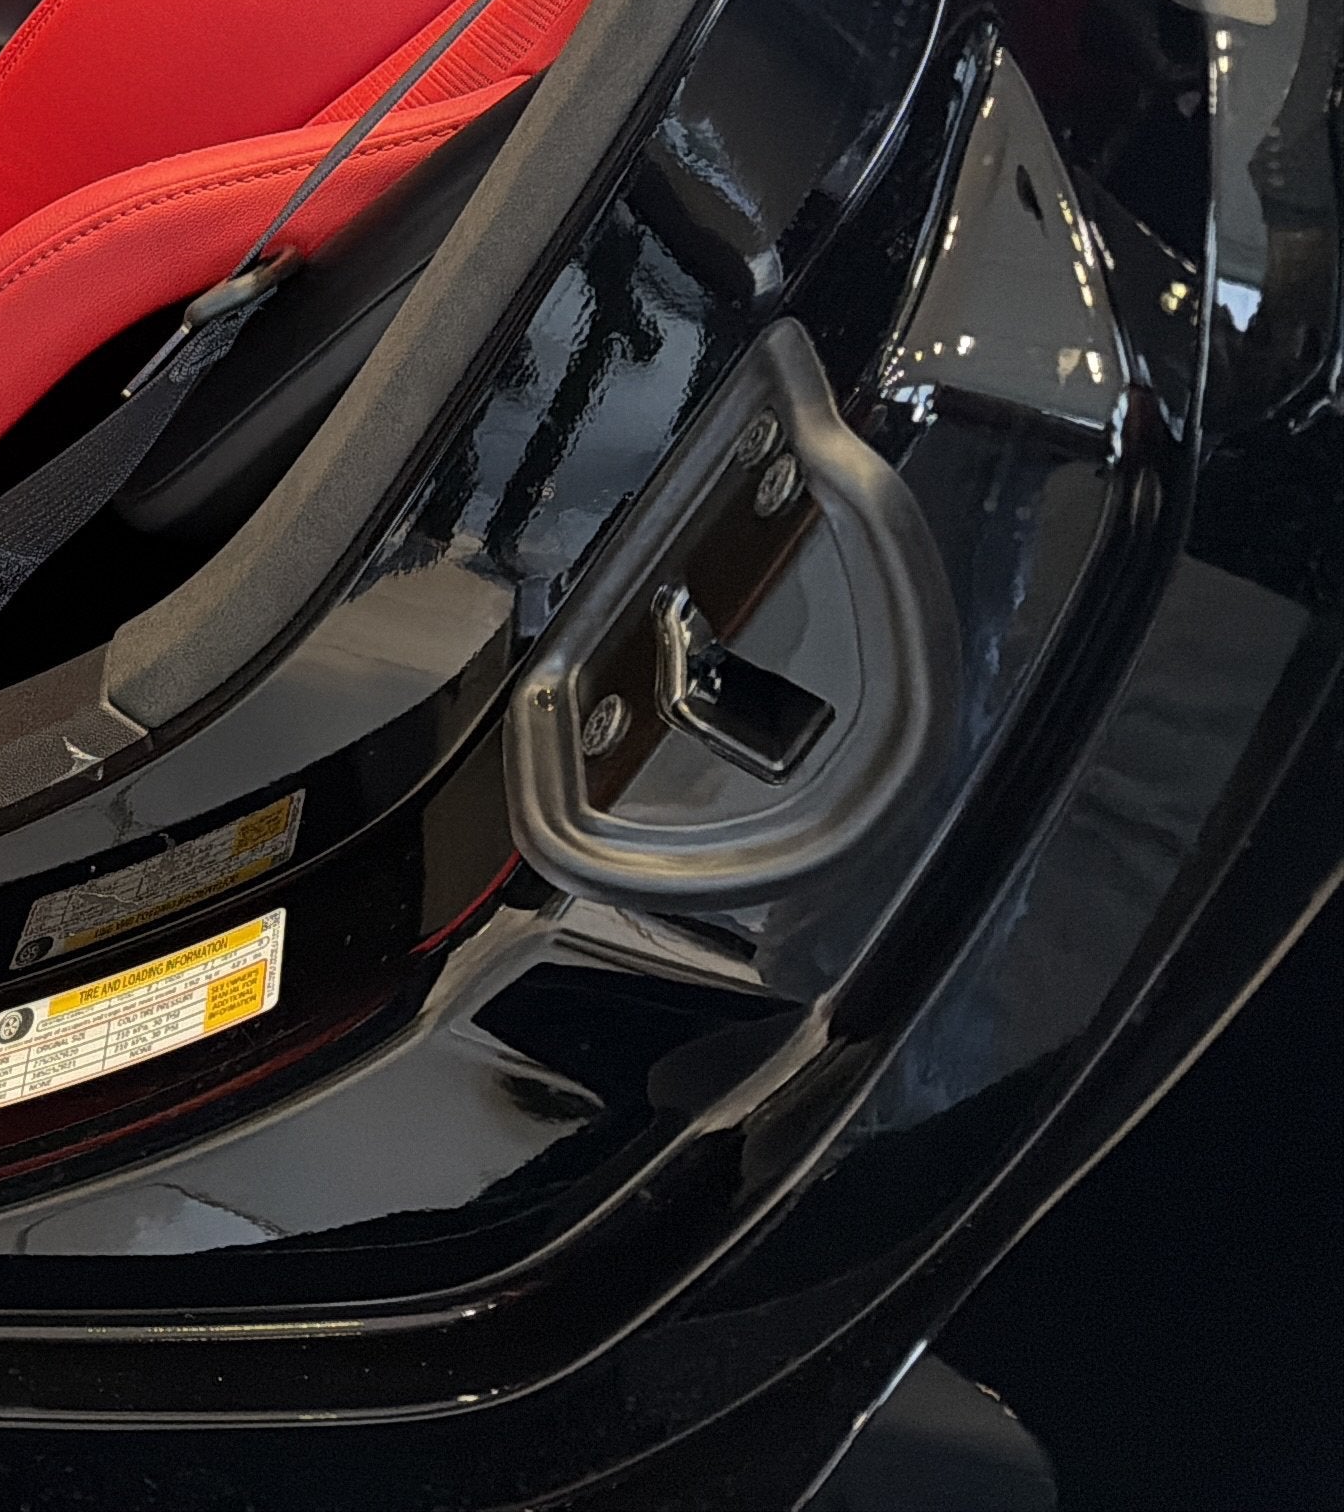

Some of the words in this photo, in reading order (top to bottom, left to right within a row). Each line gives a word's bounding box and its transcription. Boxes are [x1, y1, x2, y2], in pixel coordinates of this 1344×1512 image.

[79, 985, 99, 1003] TIRE
[100, 978, 120, 995] AND
[122, 962, 163, 987] LOADING
[165, 936, 227, 971] INFORMATION
